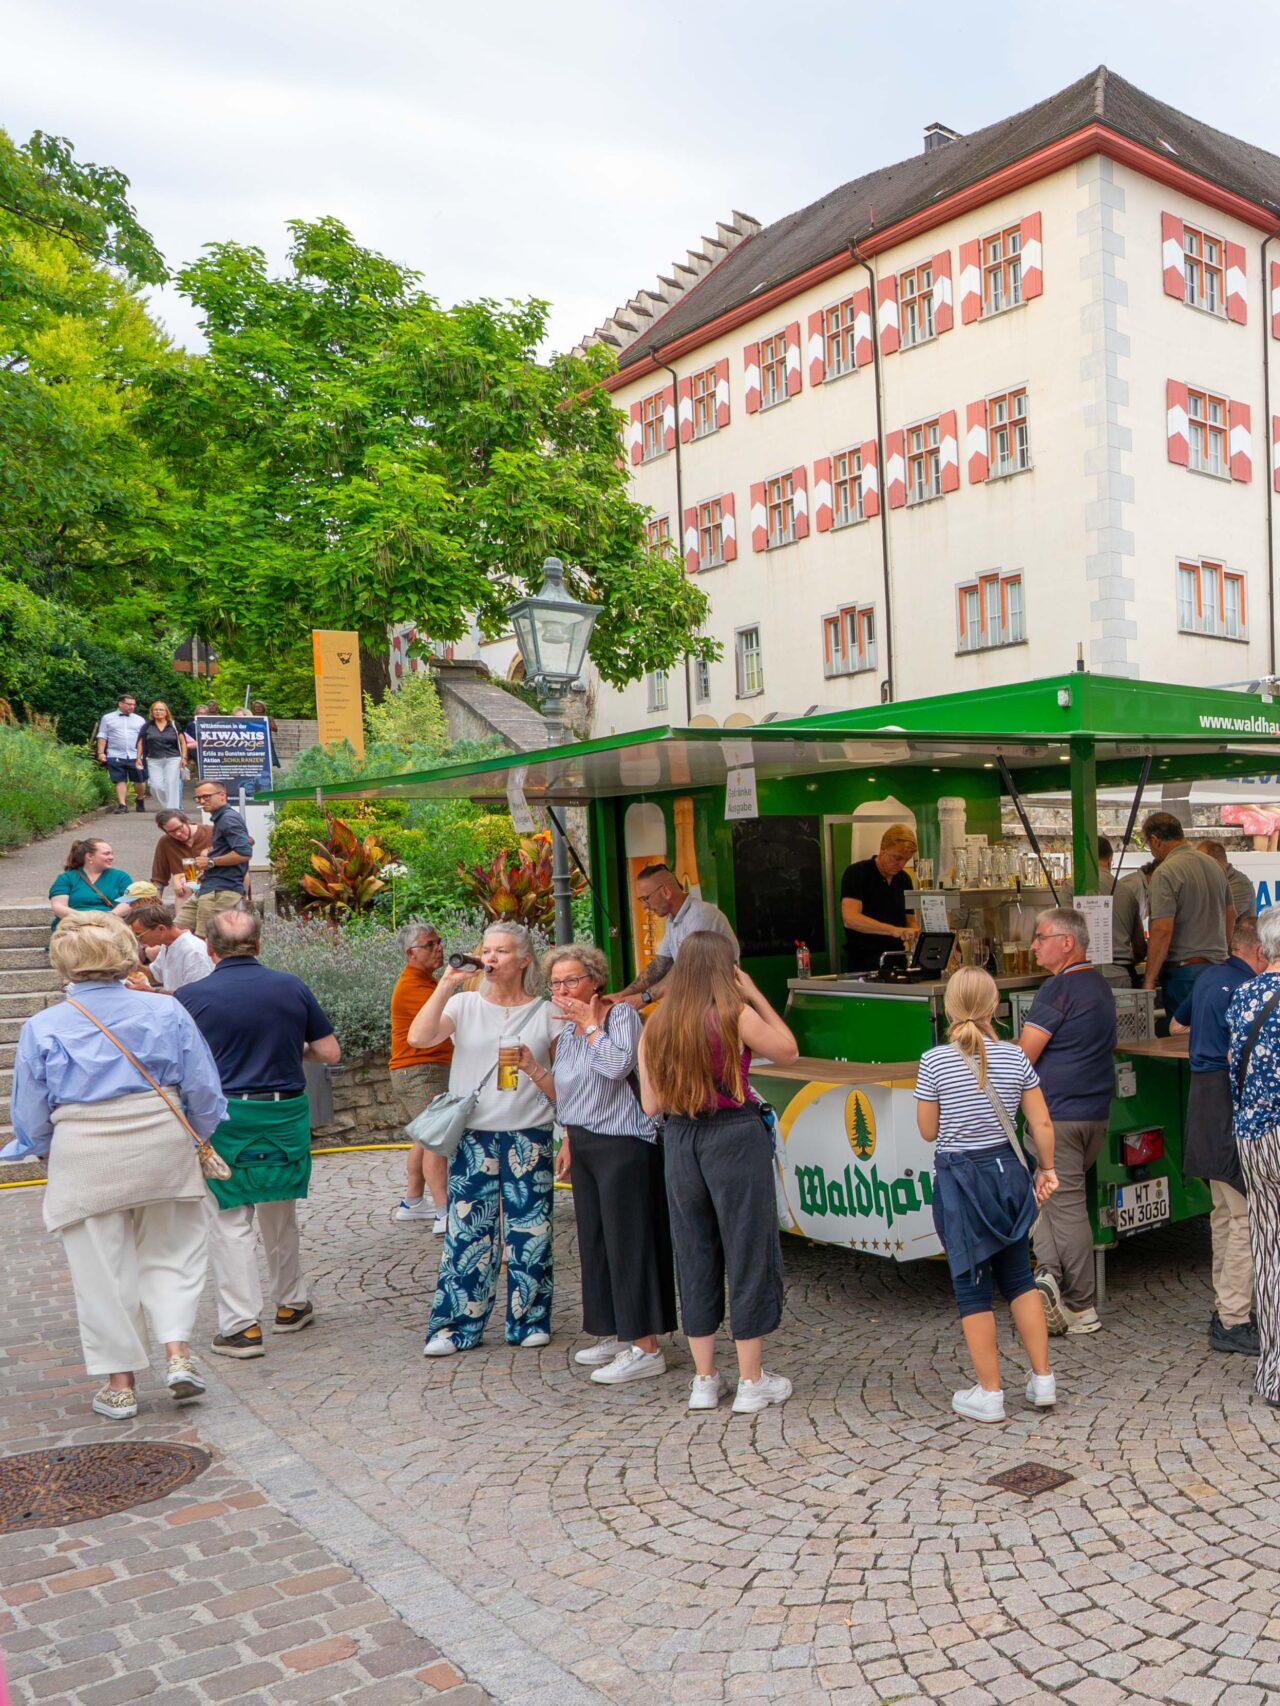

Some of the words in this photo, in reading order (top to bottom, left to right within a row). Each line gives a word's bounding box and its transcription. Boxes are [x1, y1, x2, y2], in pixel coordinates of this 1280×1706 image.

[200, 731, 265, 740] KIWANIS
[203, 739, 265, 752] Lounge
[728, 802, 752, 815] Ausgabe
[1138, 1200, 1167, 1222] 3030
